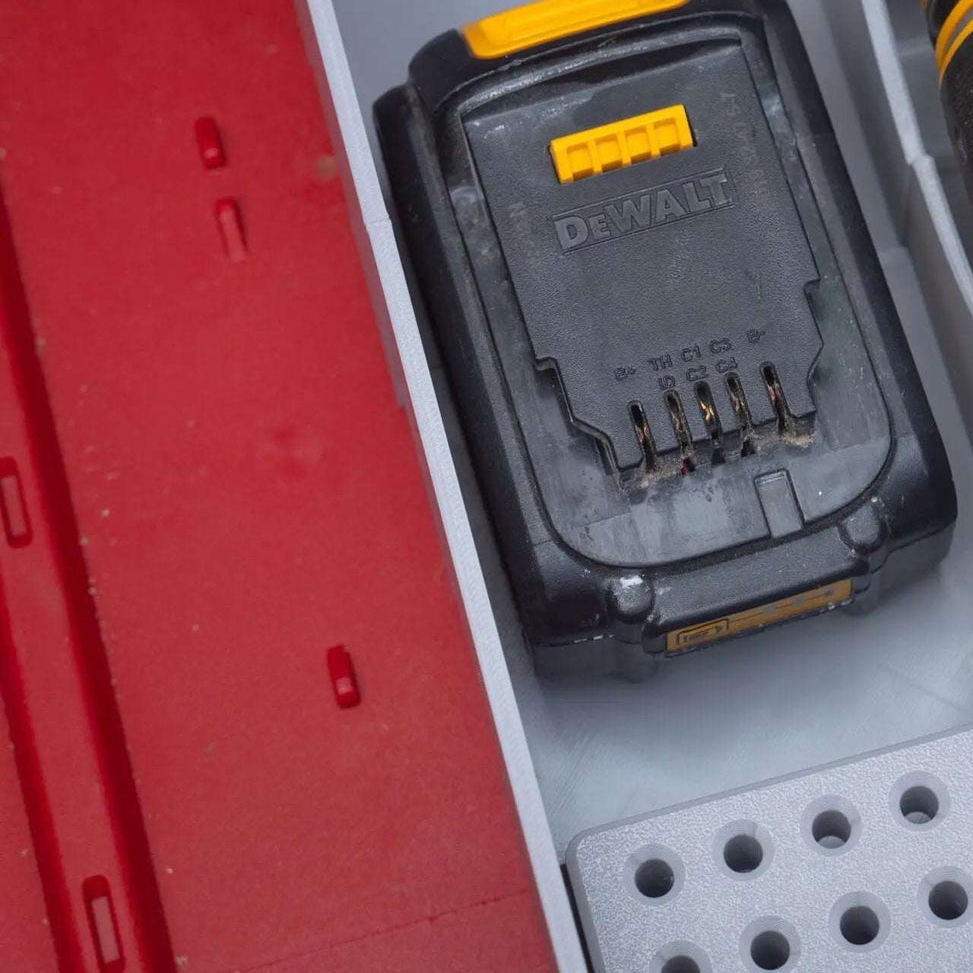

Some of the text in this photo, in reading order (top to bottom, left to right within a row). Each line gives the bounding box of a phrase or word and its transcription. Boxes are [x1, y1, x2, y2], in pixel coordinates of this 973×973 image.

[648, 354, 673, 371] TH
[681, 343, 701, 362] C1
[710, 337, 732, 354] C3
[657, 374, 676, 390] ID
[686, 366, 709, 382] C2
